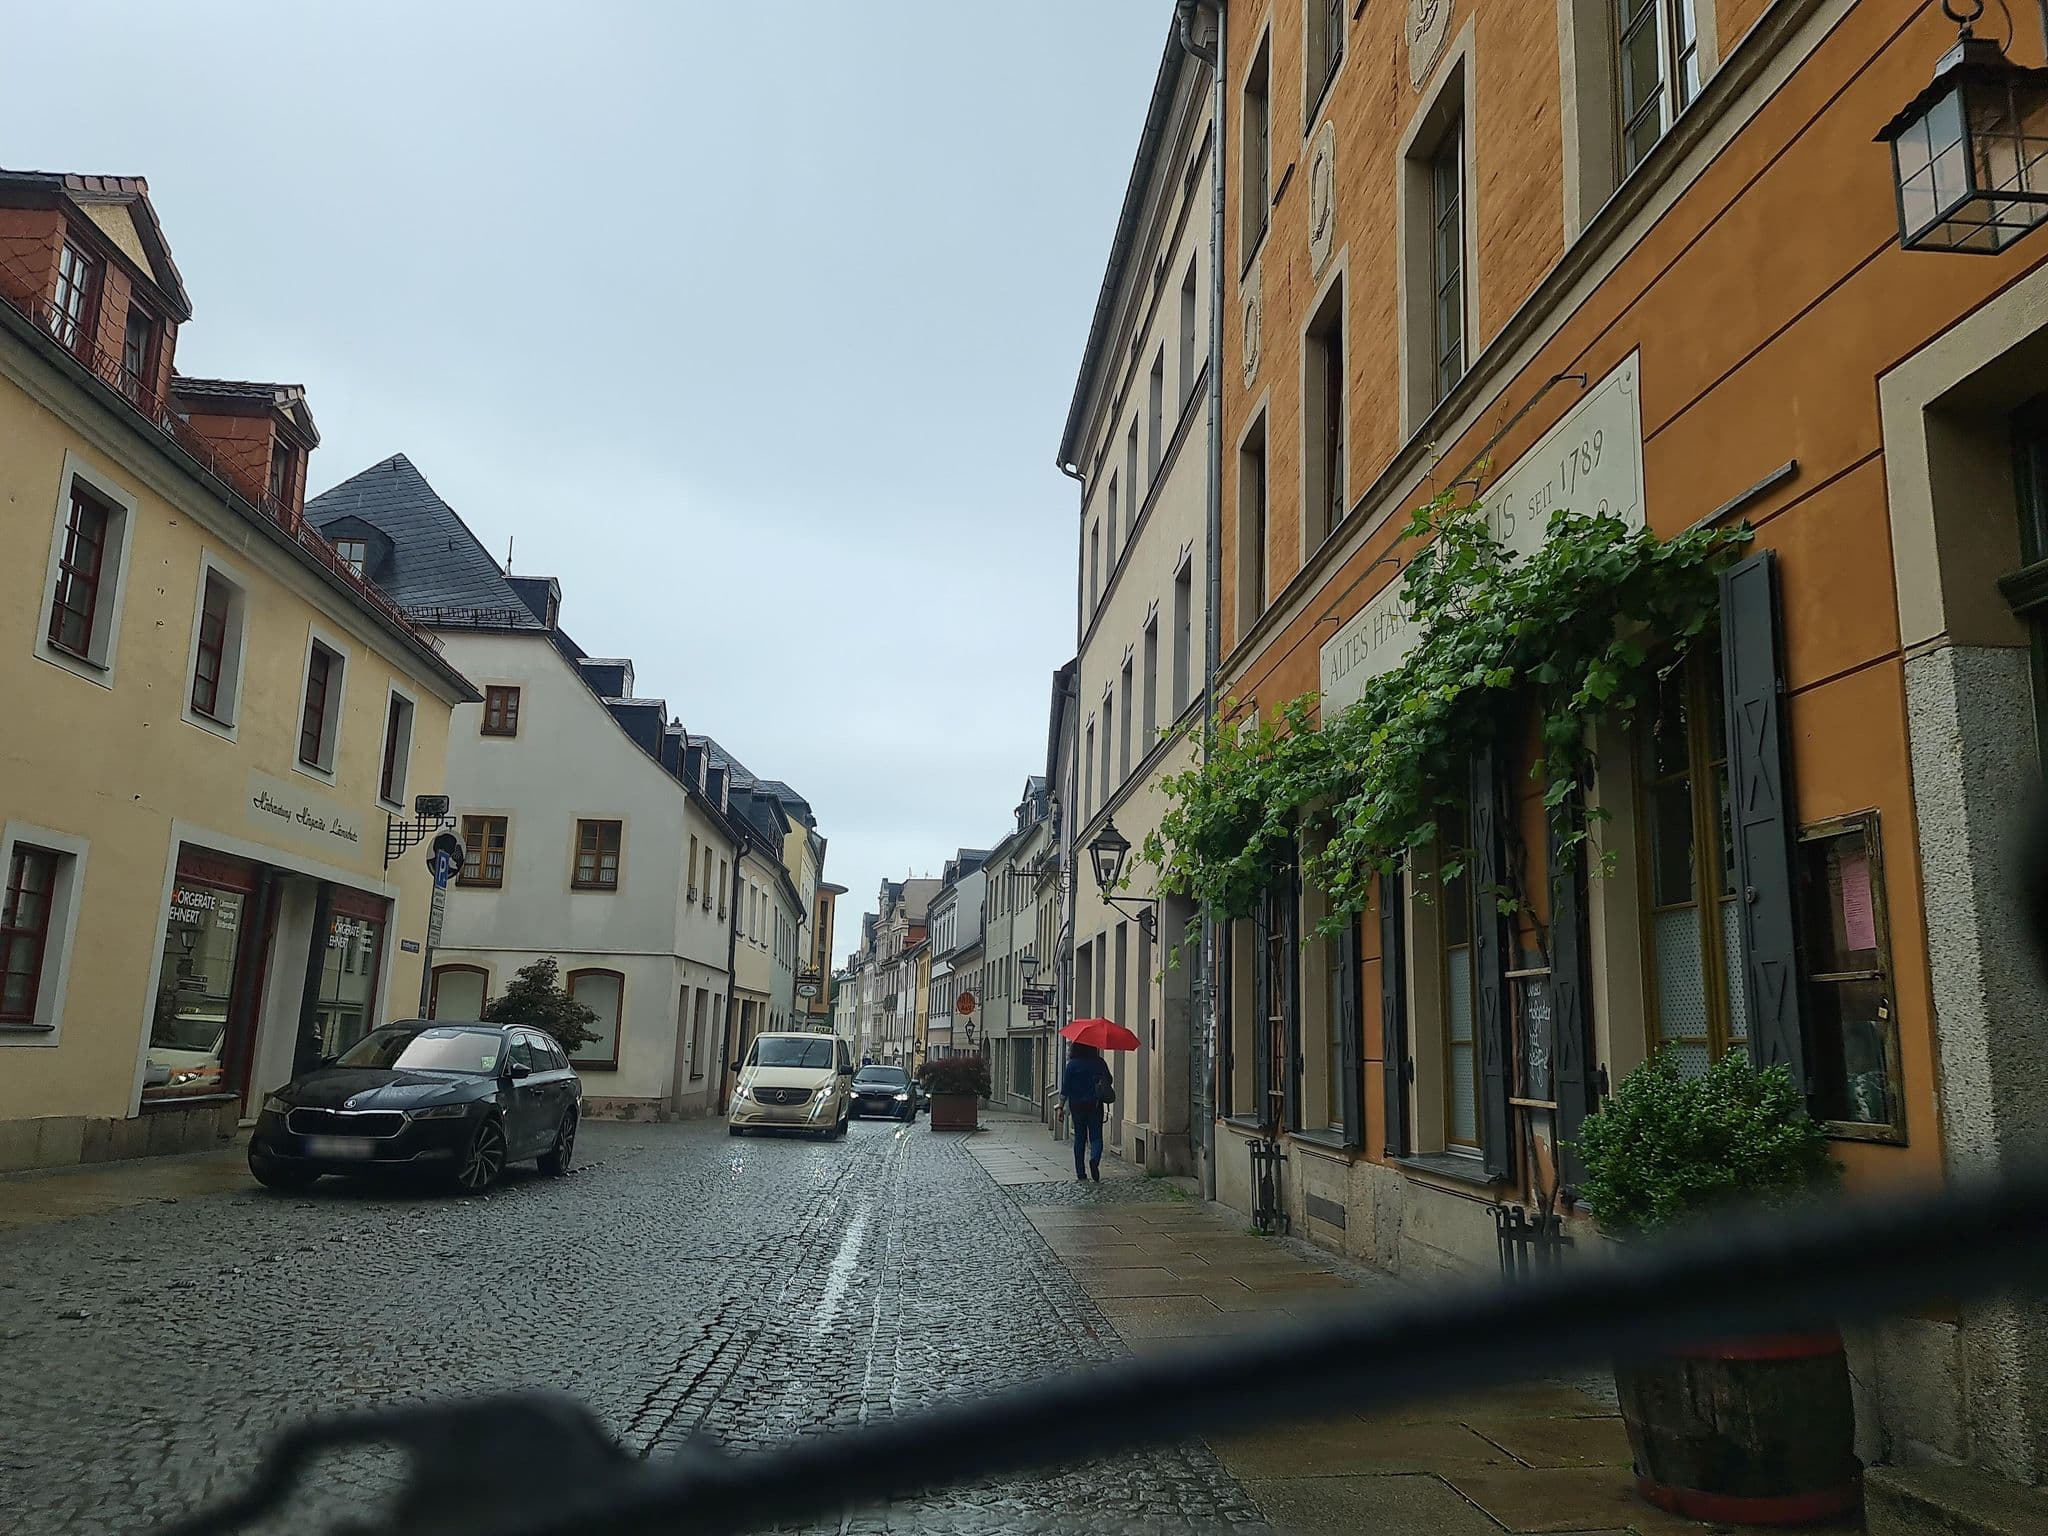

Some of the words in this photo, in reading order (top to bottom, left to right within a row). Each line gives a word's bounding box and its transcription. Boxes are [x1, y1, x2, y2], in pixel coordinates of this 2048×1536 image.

[1330, 625, 1369, 686] ALTES
[1528, 480, 1553, 521] SEIT
[1559, 429, 1603, 495] 1789
[253, 791, 293, 823] Hörberatung
[296, 806, 326, 832] Hörgeräte
[438, 855, 447, 882] P
[172, 887, 216, 910] HÖRGERÄTE
[168, 906, 200, 924] EHNERT
